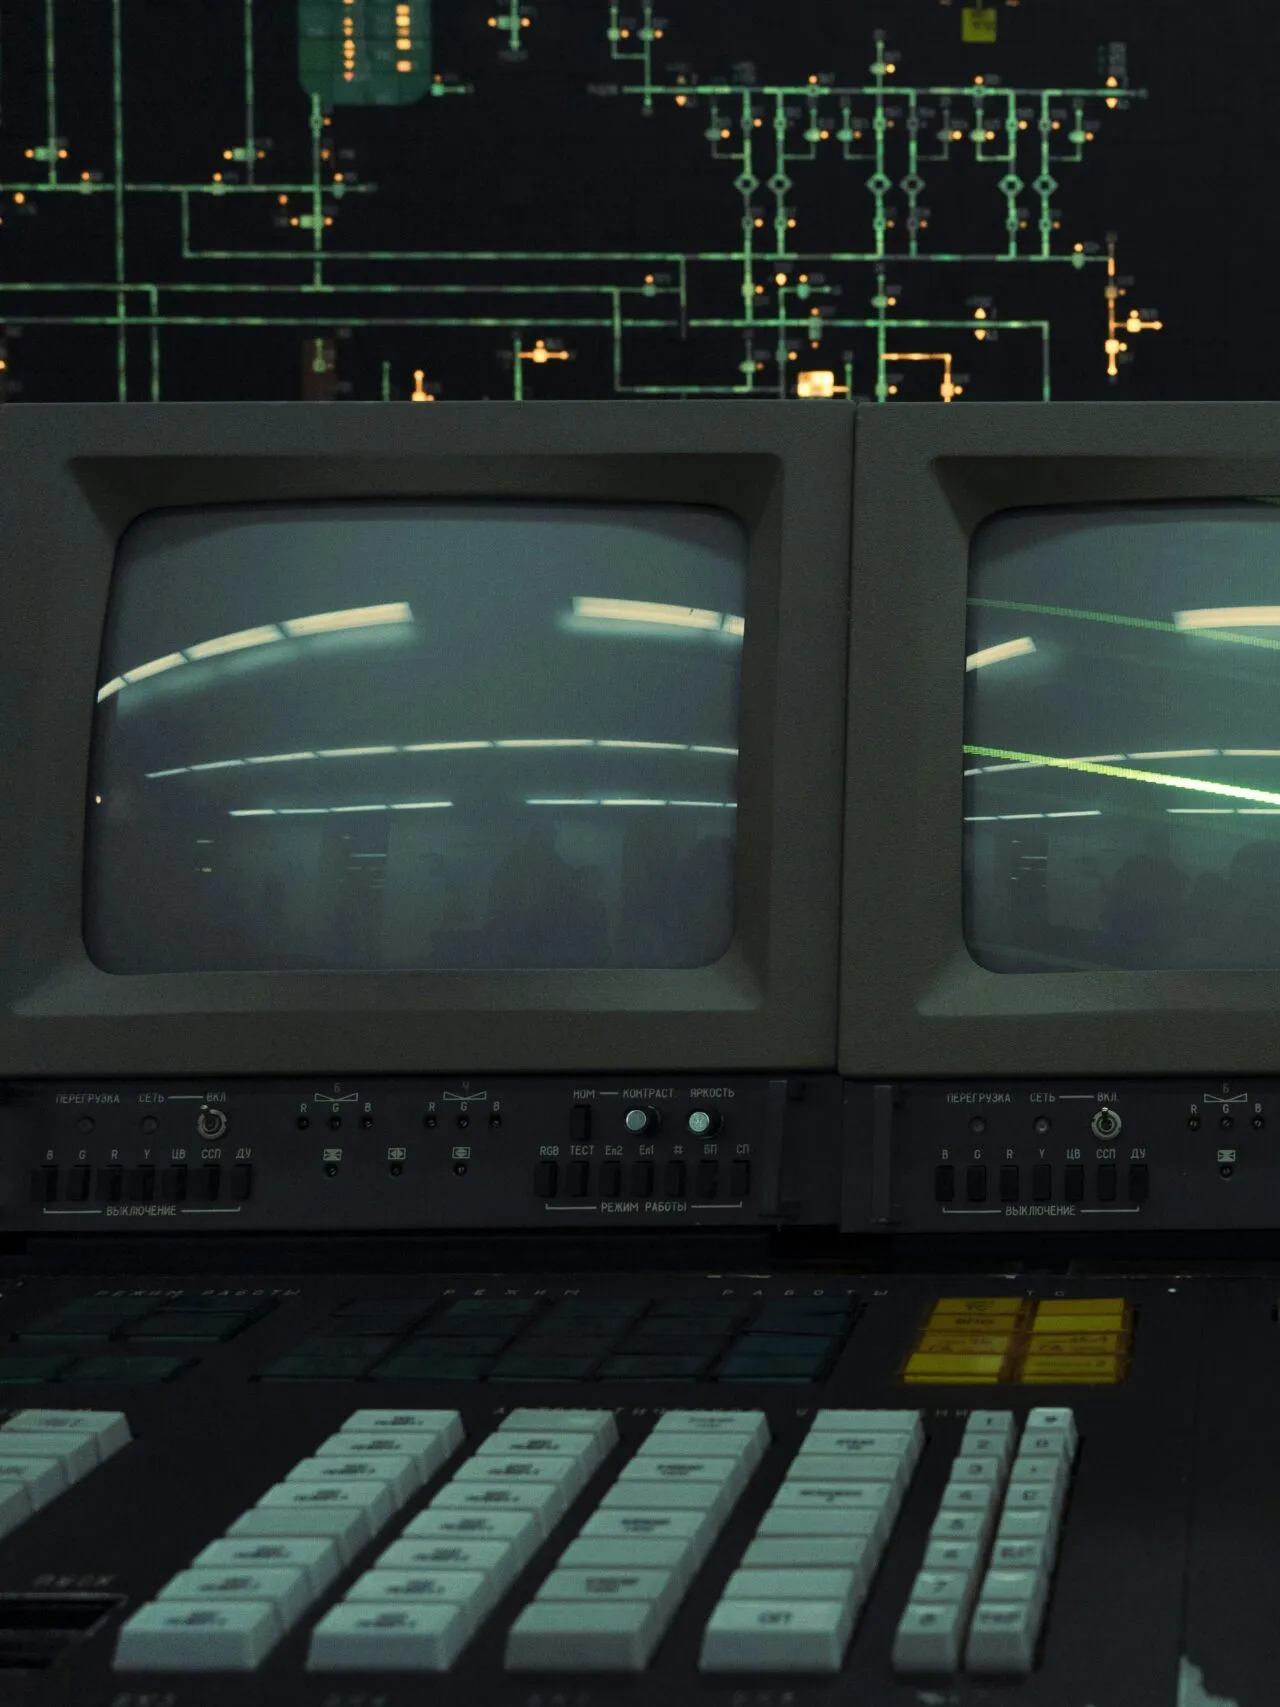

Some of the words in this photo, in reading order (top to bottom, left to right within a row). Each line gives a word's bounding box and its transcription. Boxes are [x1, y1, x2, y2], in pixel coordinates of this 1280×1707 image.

[55, 1093, 121, 1104] ПЕРЕГРУЗКА
[138, 1092, 165, 1104] СЕТЬ
[689, 1087, 735, 1099] ЯРКОСТЬ
[946, 1092, 1012, 1104] ПЕРЕГРУЗКА
[1030, 1092, 1056, 1103] СЕТЬ
[540, 1145, 560, 1157] RGB
[569, 1145, 595, 1156] ТЕСТ
[106, 1205, 177, 1217] ВЫКЛЮЧЕНИЕ
[600, 1202, 639, 1213] РЕЖИМ
[645, 1201, 687, 1212] РАБОТЫ
[1005, 1205, 1076, 1217] ВЫКЛЮЧЕНИЕ
